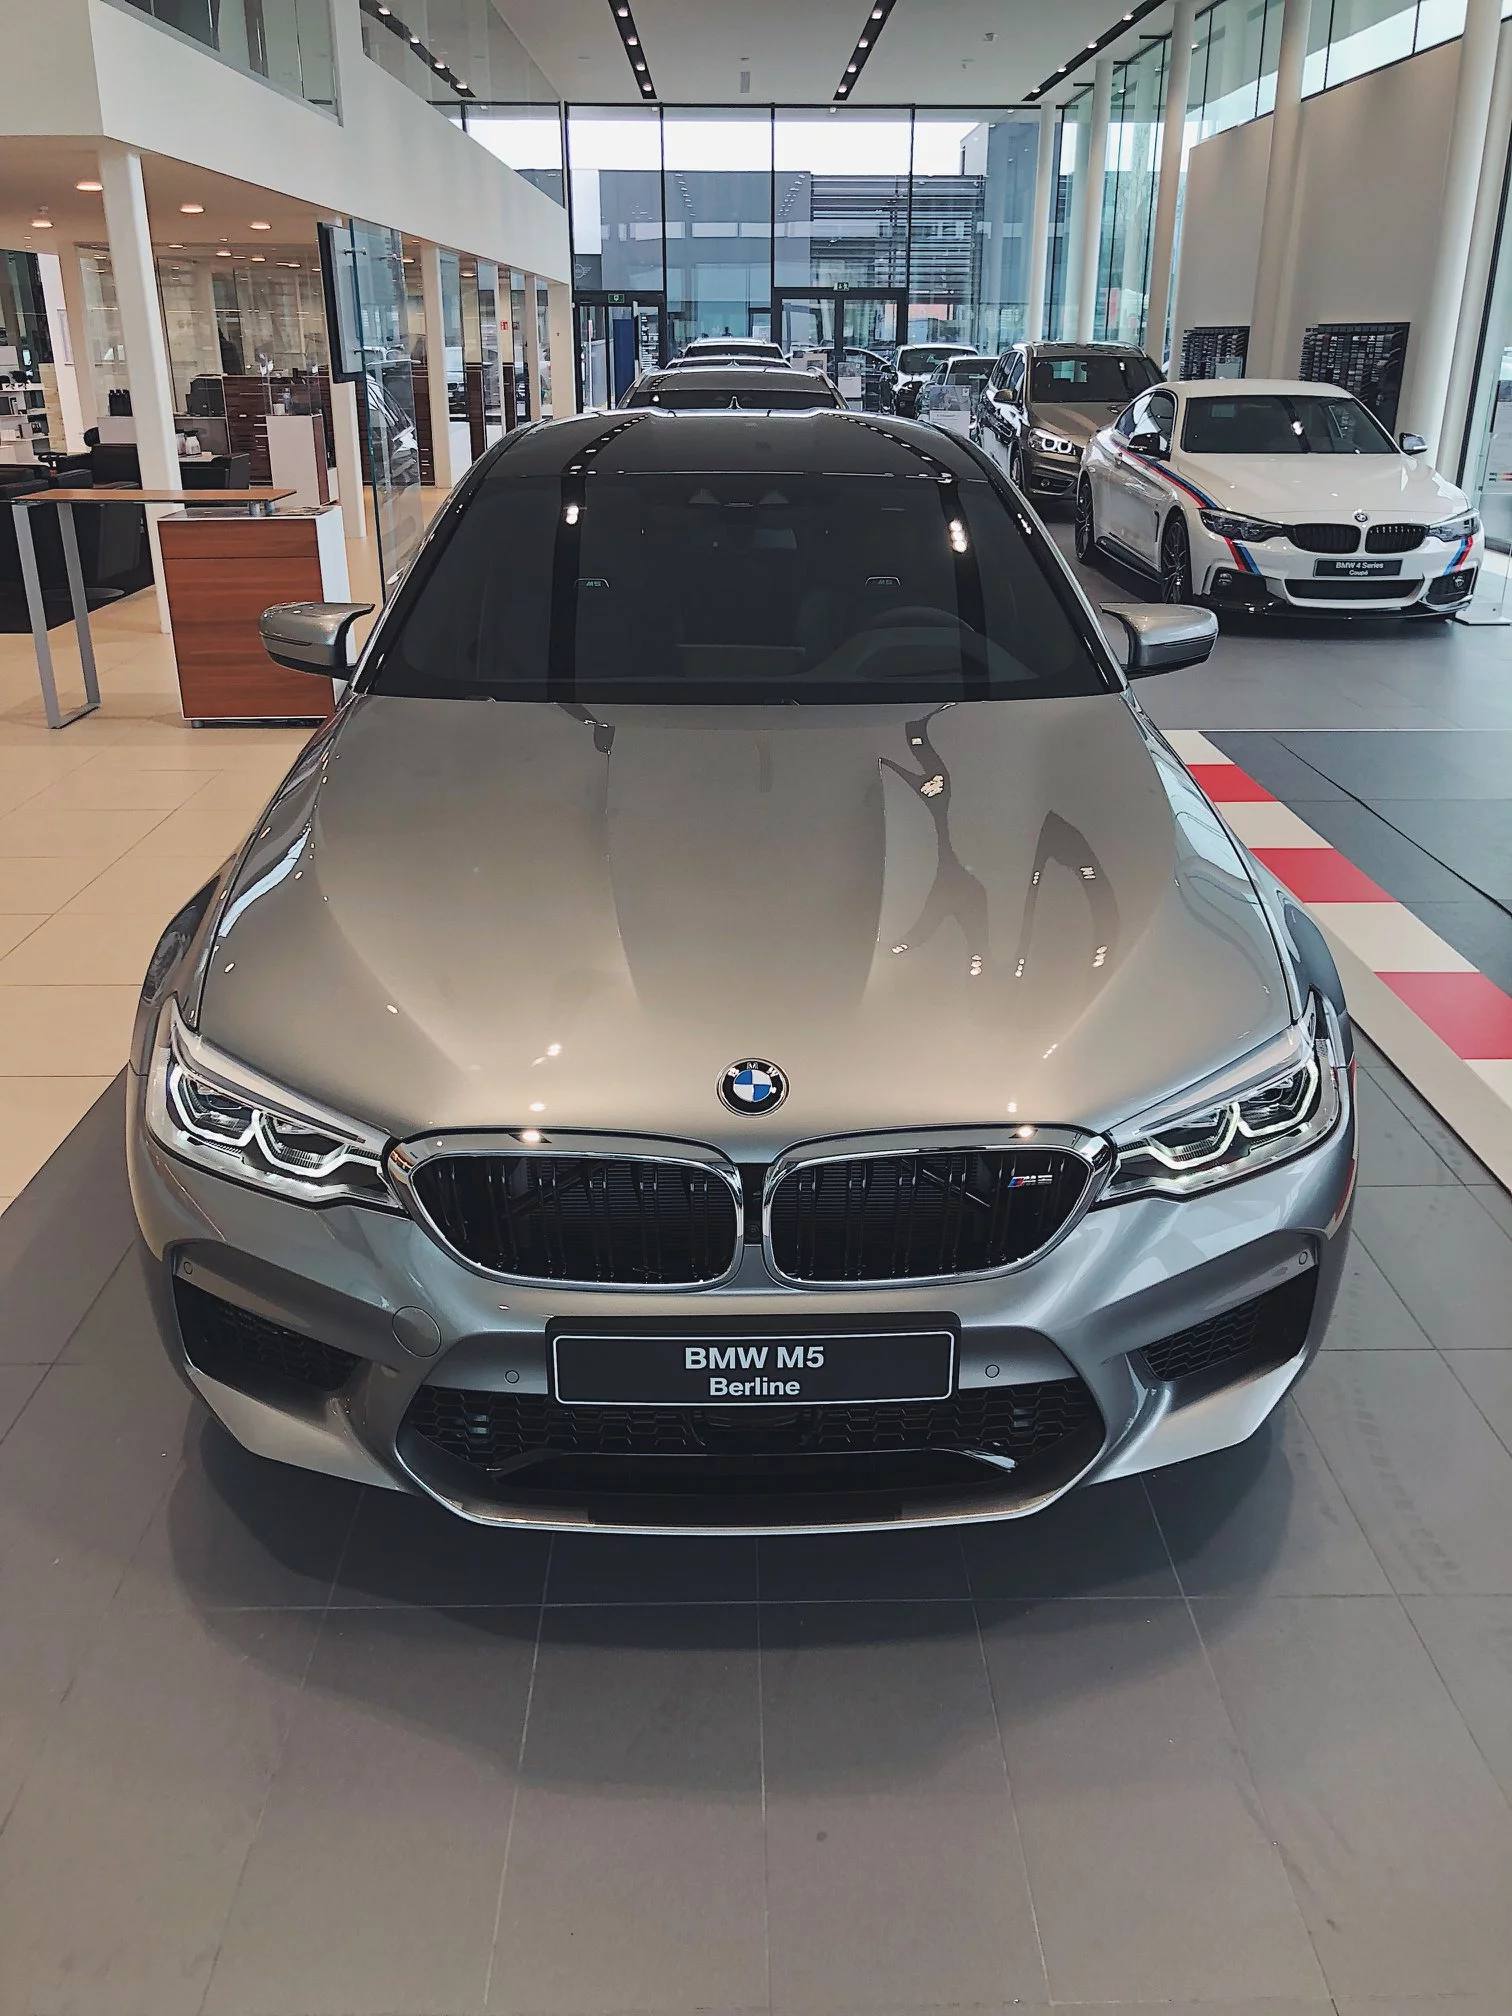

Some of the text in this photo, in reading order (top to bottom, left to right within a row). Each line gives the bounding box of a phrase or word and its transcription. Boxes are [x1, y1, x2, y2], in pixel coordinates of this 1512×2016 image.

[685, 1346, 824, 1370] BMW M5
[709, 1377, 800, 1396] Berline
